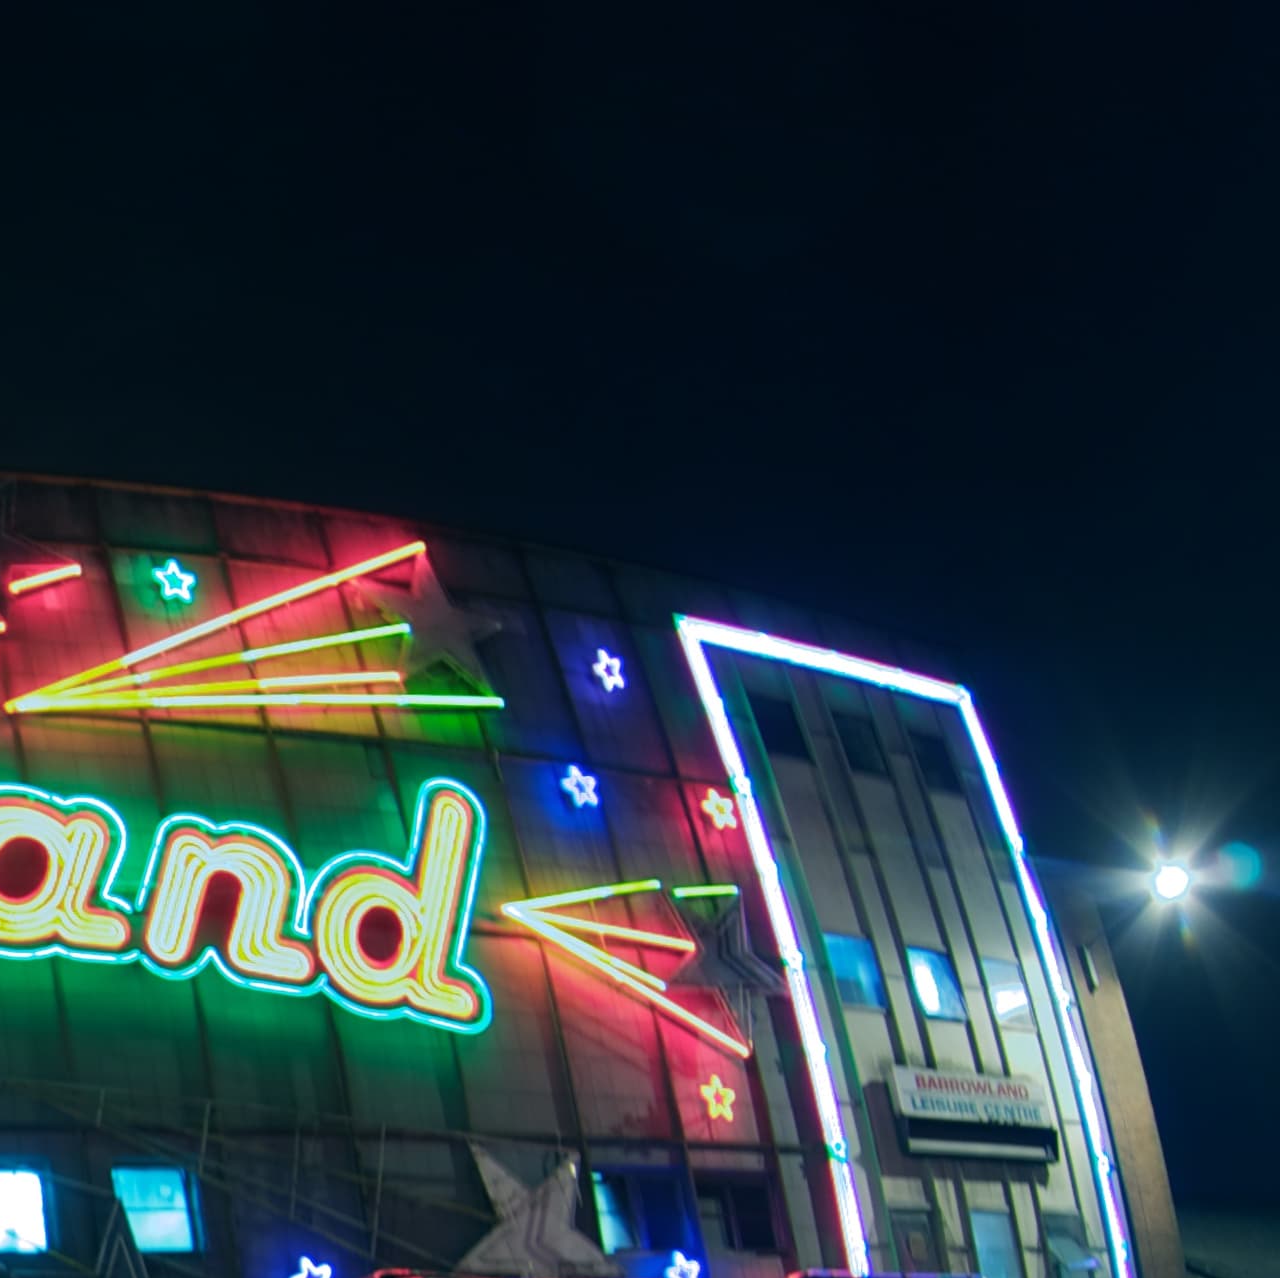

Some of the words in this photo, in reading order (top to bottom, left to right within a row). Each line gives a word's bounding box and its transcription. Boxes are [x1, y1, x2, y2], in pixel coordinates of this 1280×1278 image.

[914, 1073, 1029, 1101] BARROWLAND
[911, 1098, 978, 1116] LEISURE
[983, 1103, 1042, 1123] CENTRE
